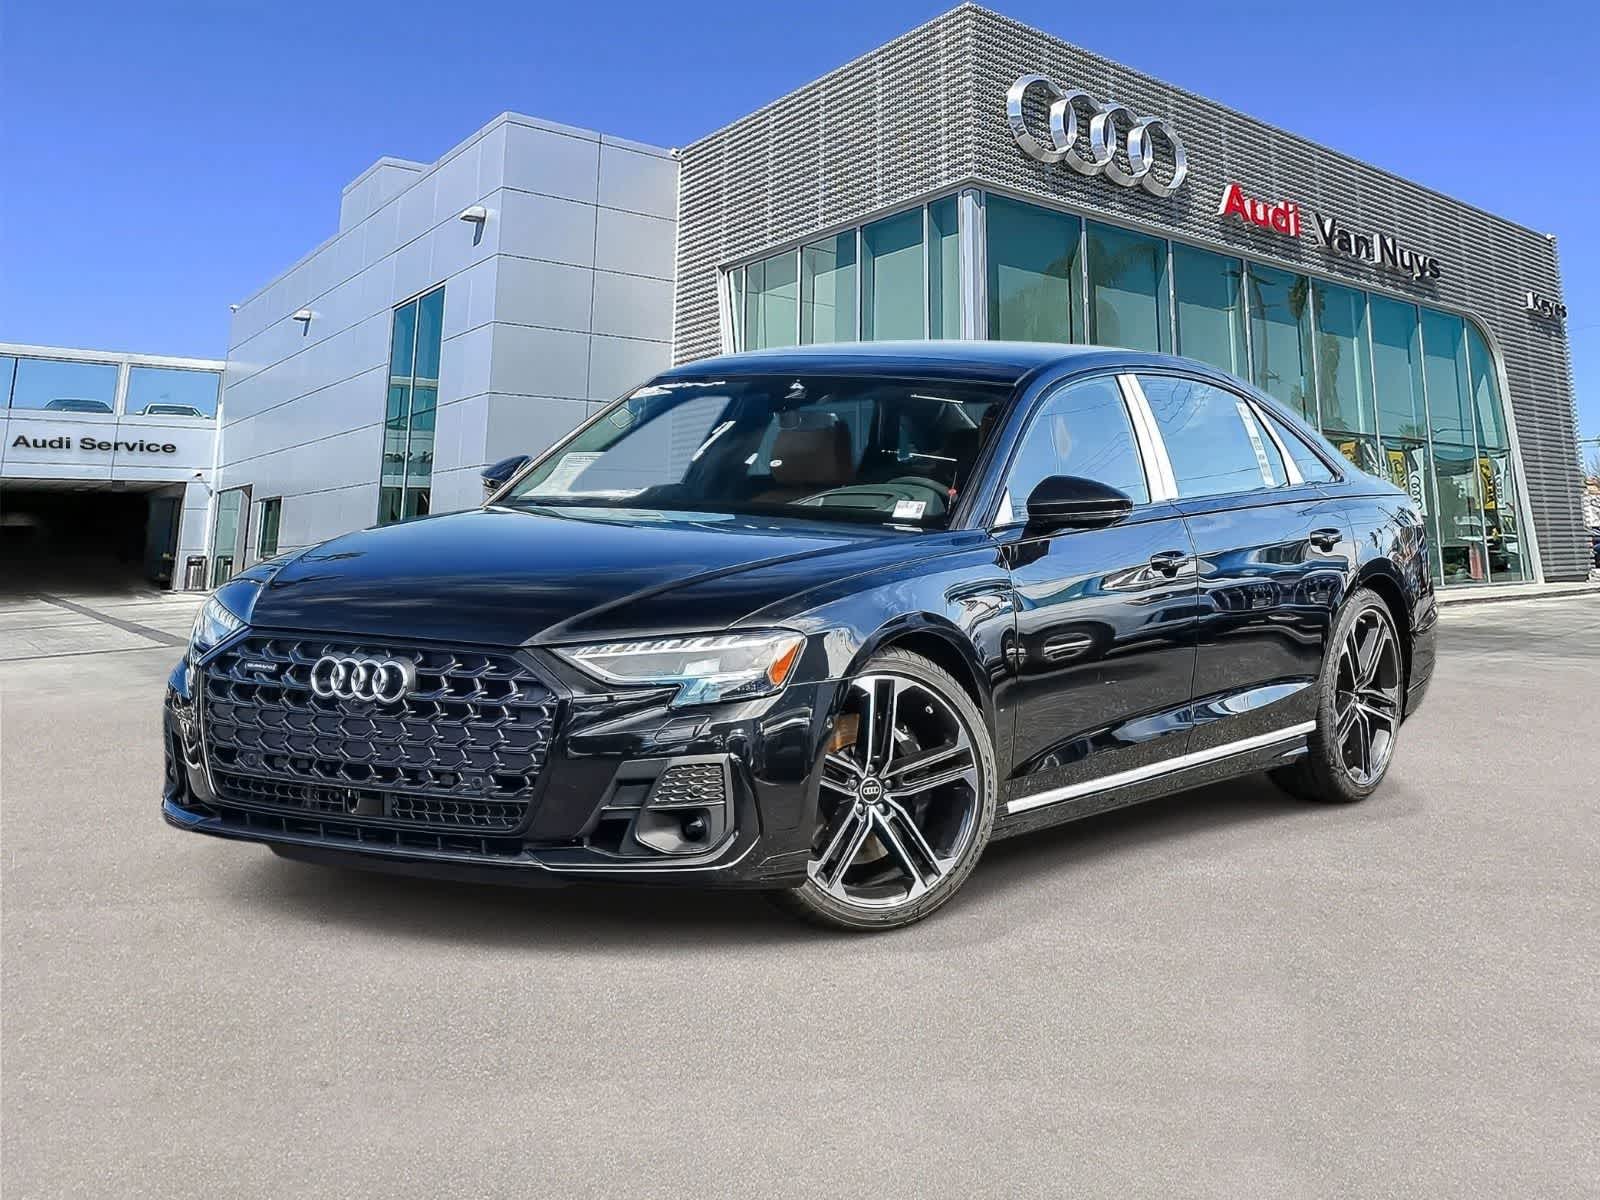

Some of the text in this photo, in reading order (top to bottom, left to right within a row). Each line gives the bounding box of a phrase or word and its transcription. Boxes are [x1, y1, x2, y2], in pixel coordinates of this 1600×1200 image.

[1218, 184, 1441, 281] Audi Van Nuys
[12, 435, 177, 453] Audi Service
